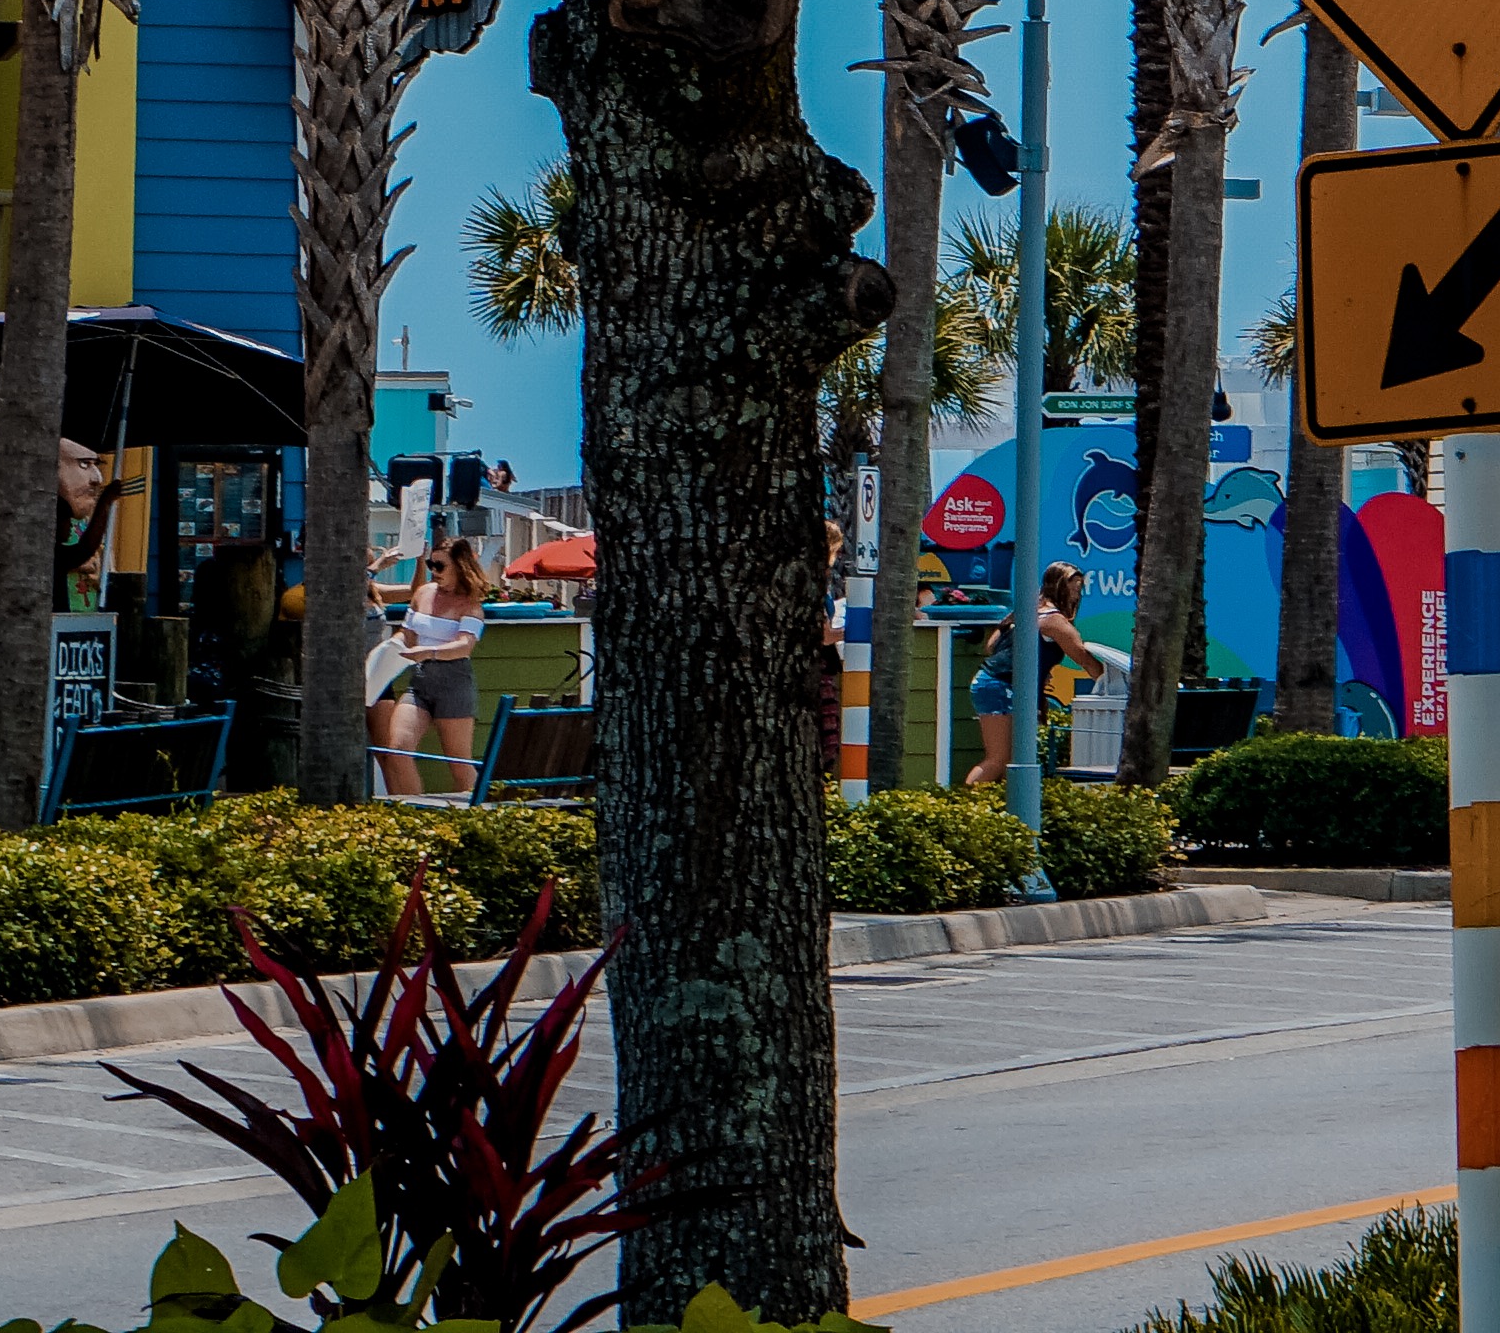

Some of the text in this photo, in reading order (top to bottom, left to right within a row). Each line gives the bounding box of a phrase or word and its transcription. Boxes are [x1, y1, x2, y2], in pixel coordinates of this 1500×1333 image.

[944, 496, 974, 511] Ask
[944, 512, 994, 524] Swimming
[58, 636, 104, 676] DICK'S
[1421, 590, 1435, 726] EXPERIENCE
[1436, 704, 1445, 721] OF
